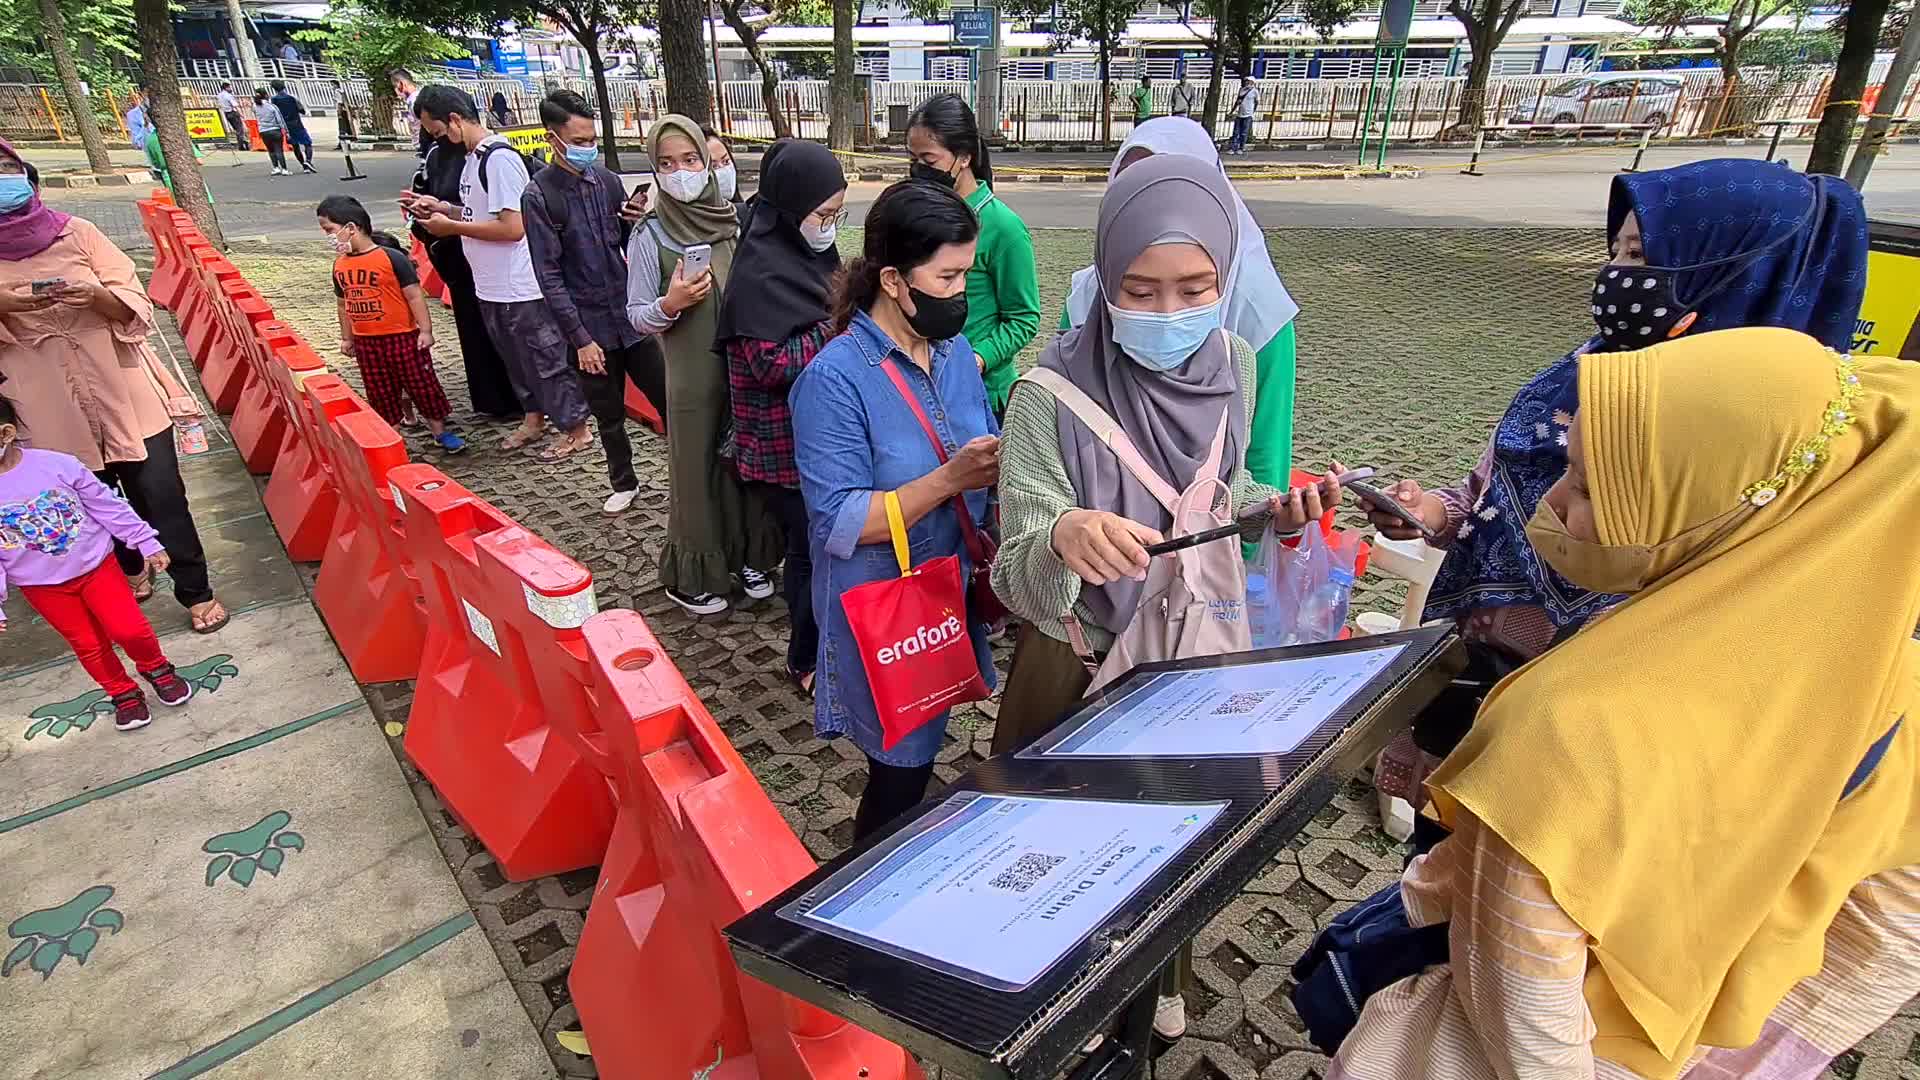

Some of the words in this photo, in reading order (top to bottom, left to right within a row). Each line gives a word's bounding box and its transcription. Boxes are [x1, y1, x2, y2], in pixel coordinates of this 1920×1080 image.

[960, 21, 987, 30] KELUAR
[963, 13, 985, 21] MOBIL
[337, 269, 379, 287] RIDE
[876, 614, 962, 666] erafone
[1303, 676, 1337, 696] Scan
[989, 844, 1017, 862] Pintu
[1091, 844, 1138, 876] Scan
[962, 861, 991, 881] Utara
[1039, 879, 1097, 920] Disini
